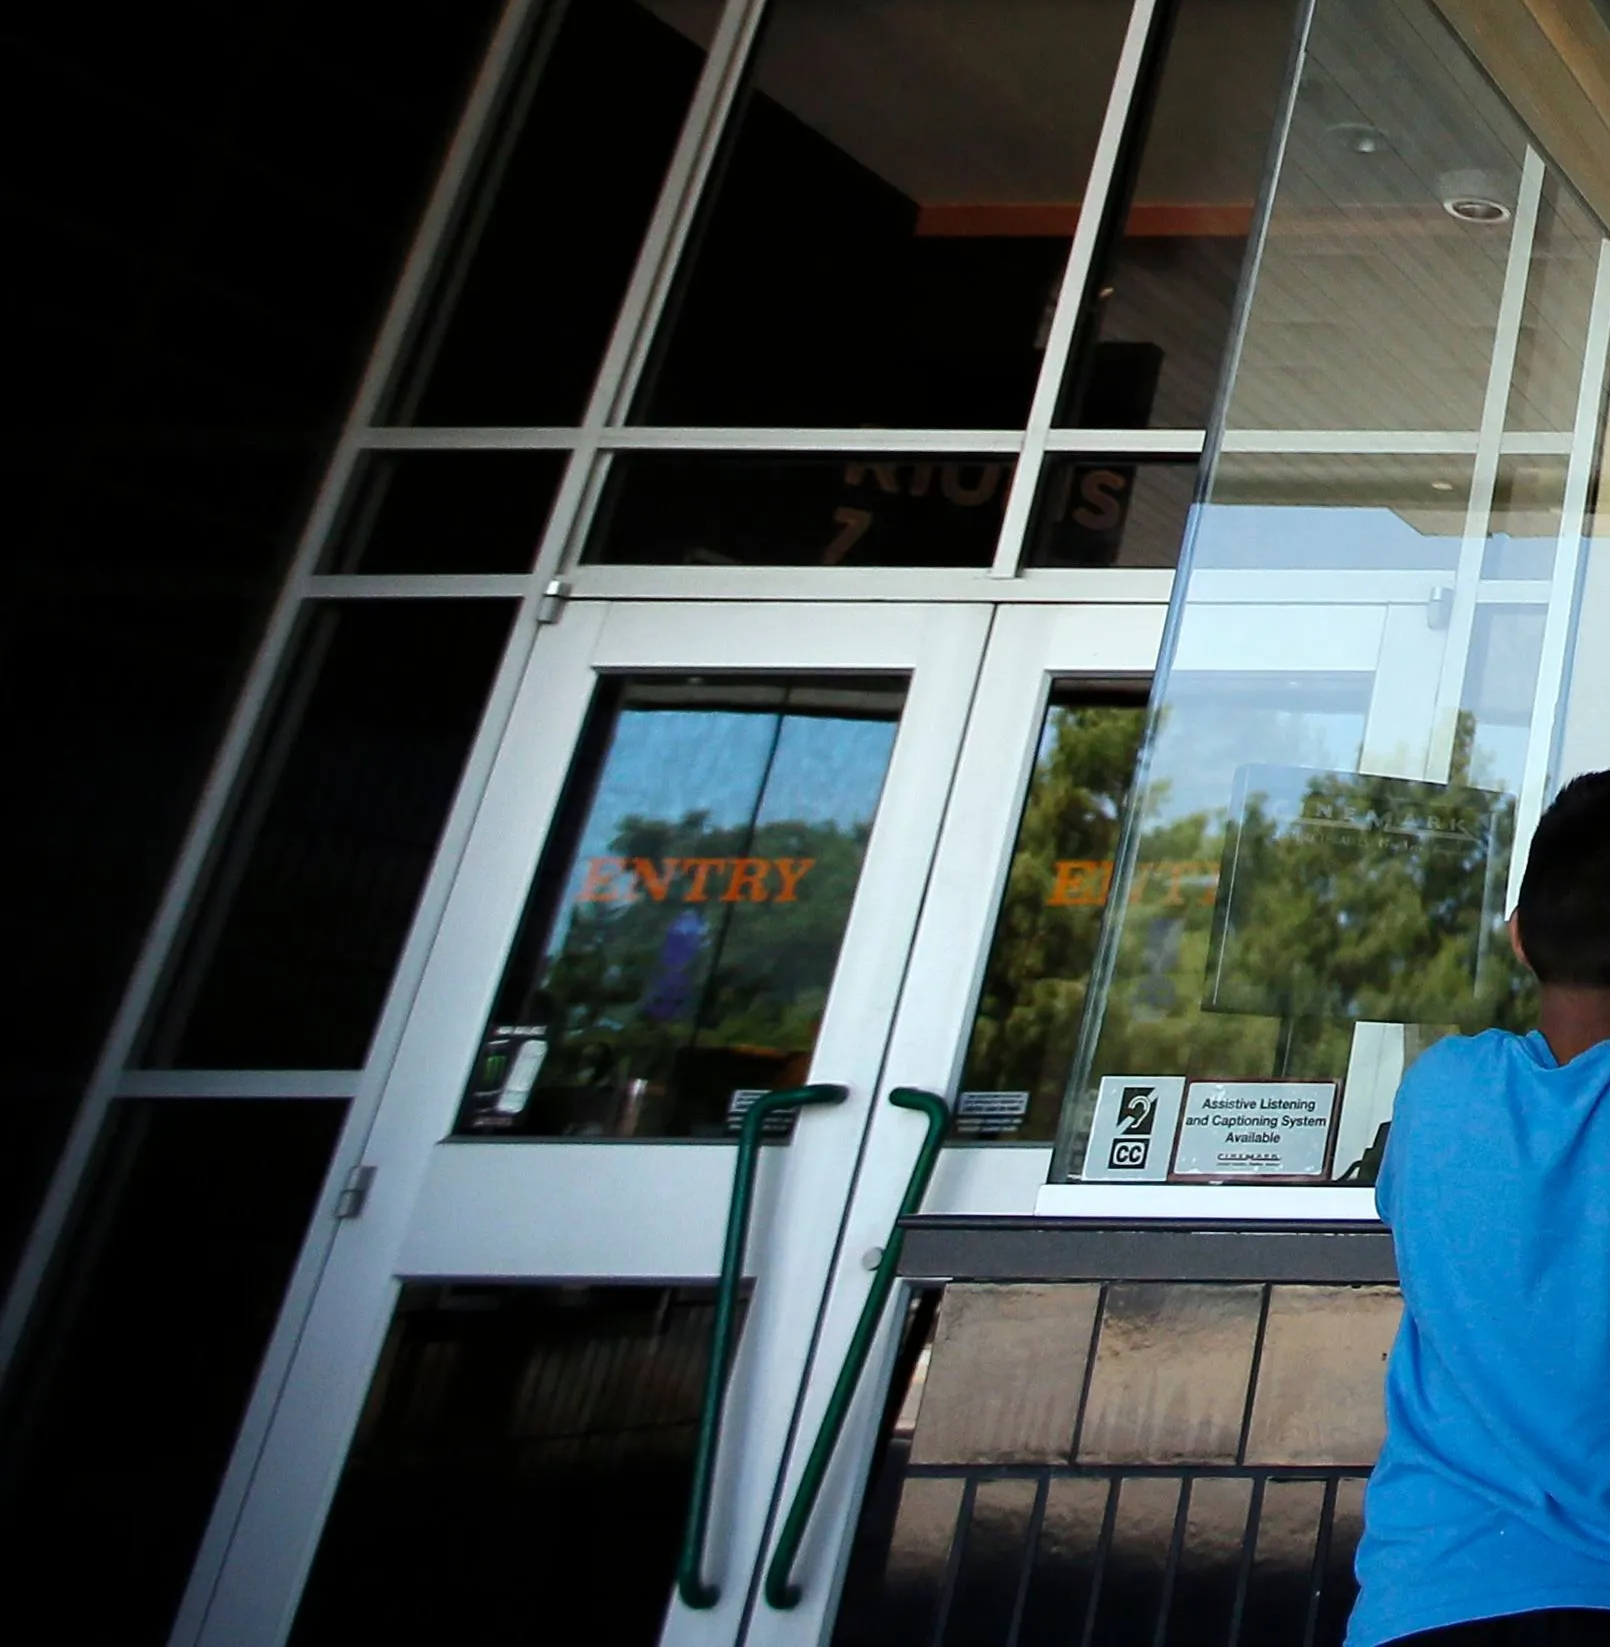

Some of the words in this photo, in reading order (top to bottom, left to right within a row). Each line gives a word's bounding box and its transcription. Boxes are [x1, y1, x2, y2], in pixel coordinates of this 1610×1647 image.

[1270, 798, 1484, 842] CINEMARK
[574, 856, 816, 904] ENTRY
[1202, 1098, 1256, 1110] Assistive
[1260, 1098, 1315, 1112] Listening
[1186, 1115, 1208, 1126] and
[1212, 1115, 1277, 1128] Captioning
[1281, 1115, 1326, 1127] System
[1225, 1132, 1280, 1143] Available
[1116, 1145, 1143, 1165] CC
